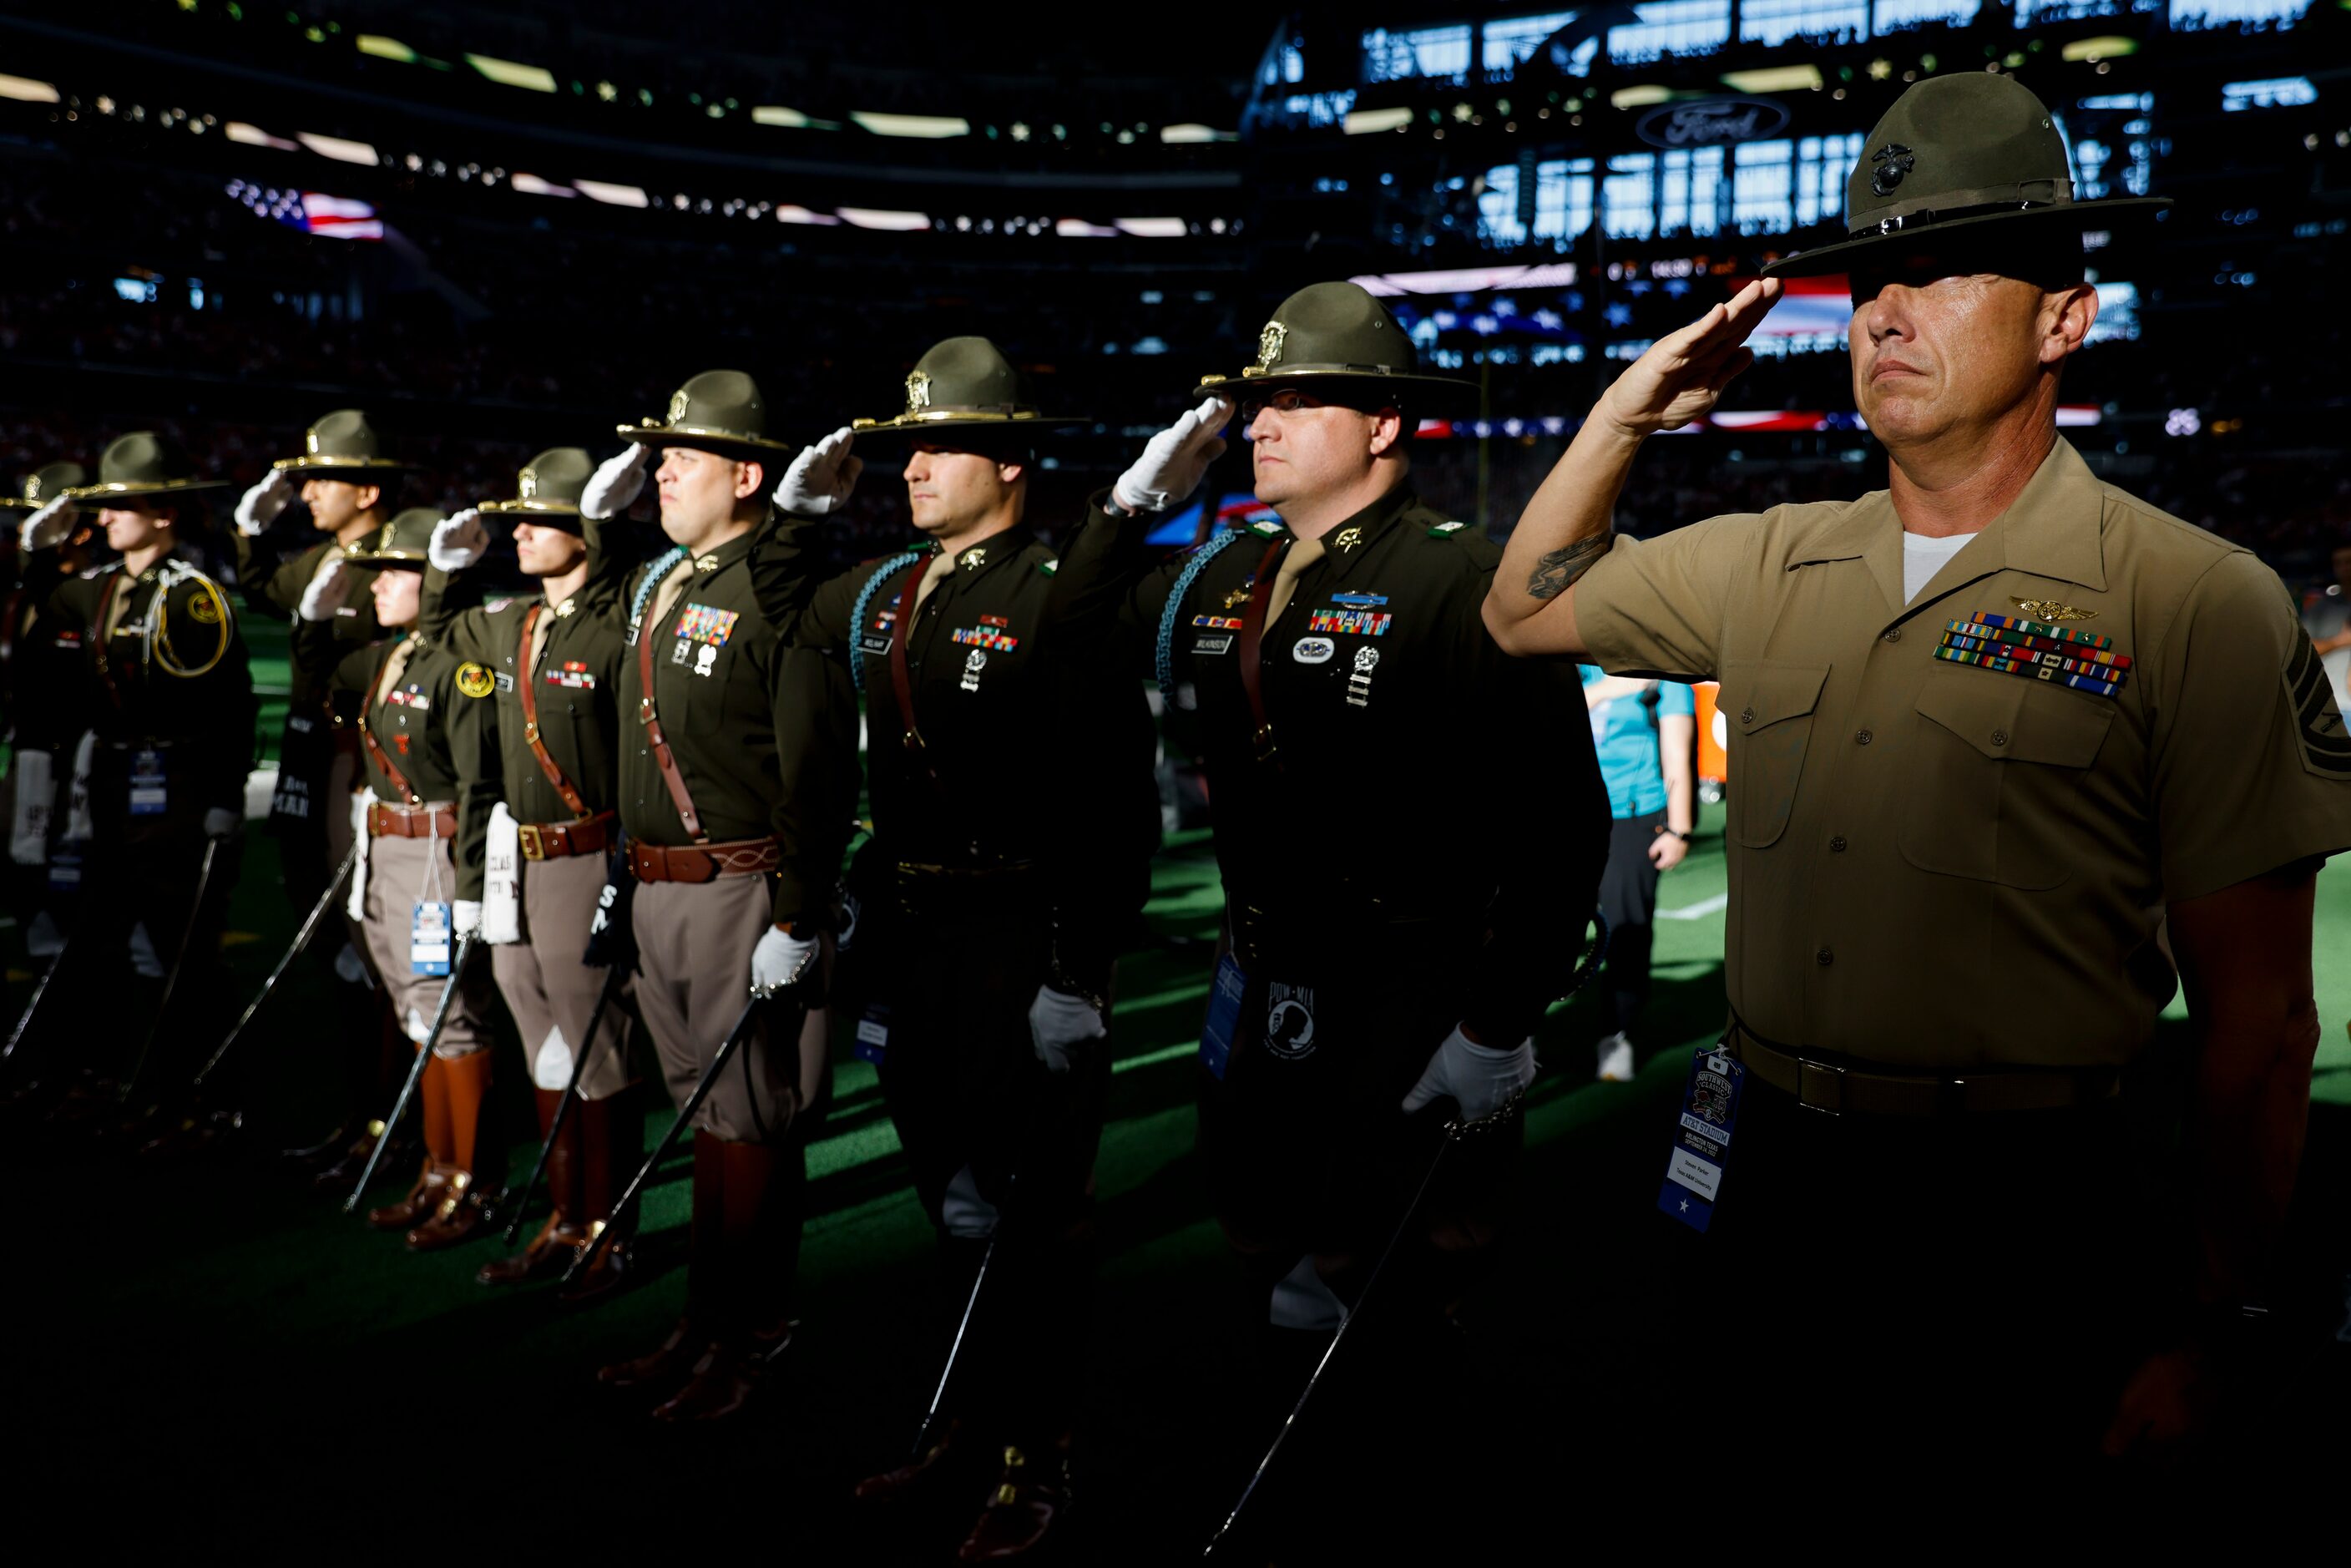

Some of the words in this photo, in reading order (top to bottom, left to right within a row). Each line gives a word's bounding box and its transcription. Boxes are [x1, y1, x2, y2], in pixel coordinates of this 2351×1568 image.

[1664, 103, 1761, 144] Ford
[1268, 980, 1292, 1013] POW
[1297, 984, 1315, 1016] MIA
[1697, 1073, 1732, 1095] SOUTHWEST
[1700, 1081, 1728, 1096] CLASSIC
[1682, 1115, 1700, 1130] AT&T
[1699, 1123, 1728, 1145] STADIUM
[1685, 1131, 1706, 1146] ARLINGTON
[1706, 1141, 1718, 1152] TEXAS
[1685, 1138, 1703, 1151] SEPTEMBER
[1685, 1159, 1696, 1170] Steven
[1697, 1166, 1709, 1176] Parker
[1676, 1167, 1686, 1176] Texas
[1686, 1172, 1695, 1181] A&M
[1694, 1177, 1712, 1191] University
